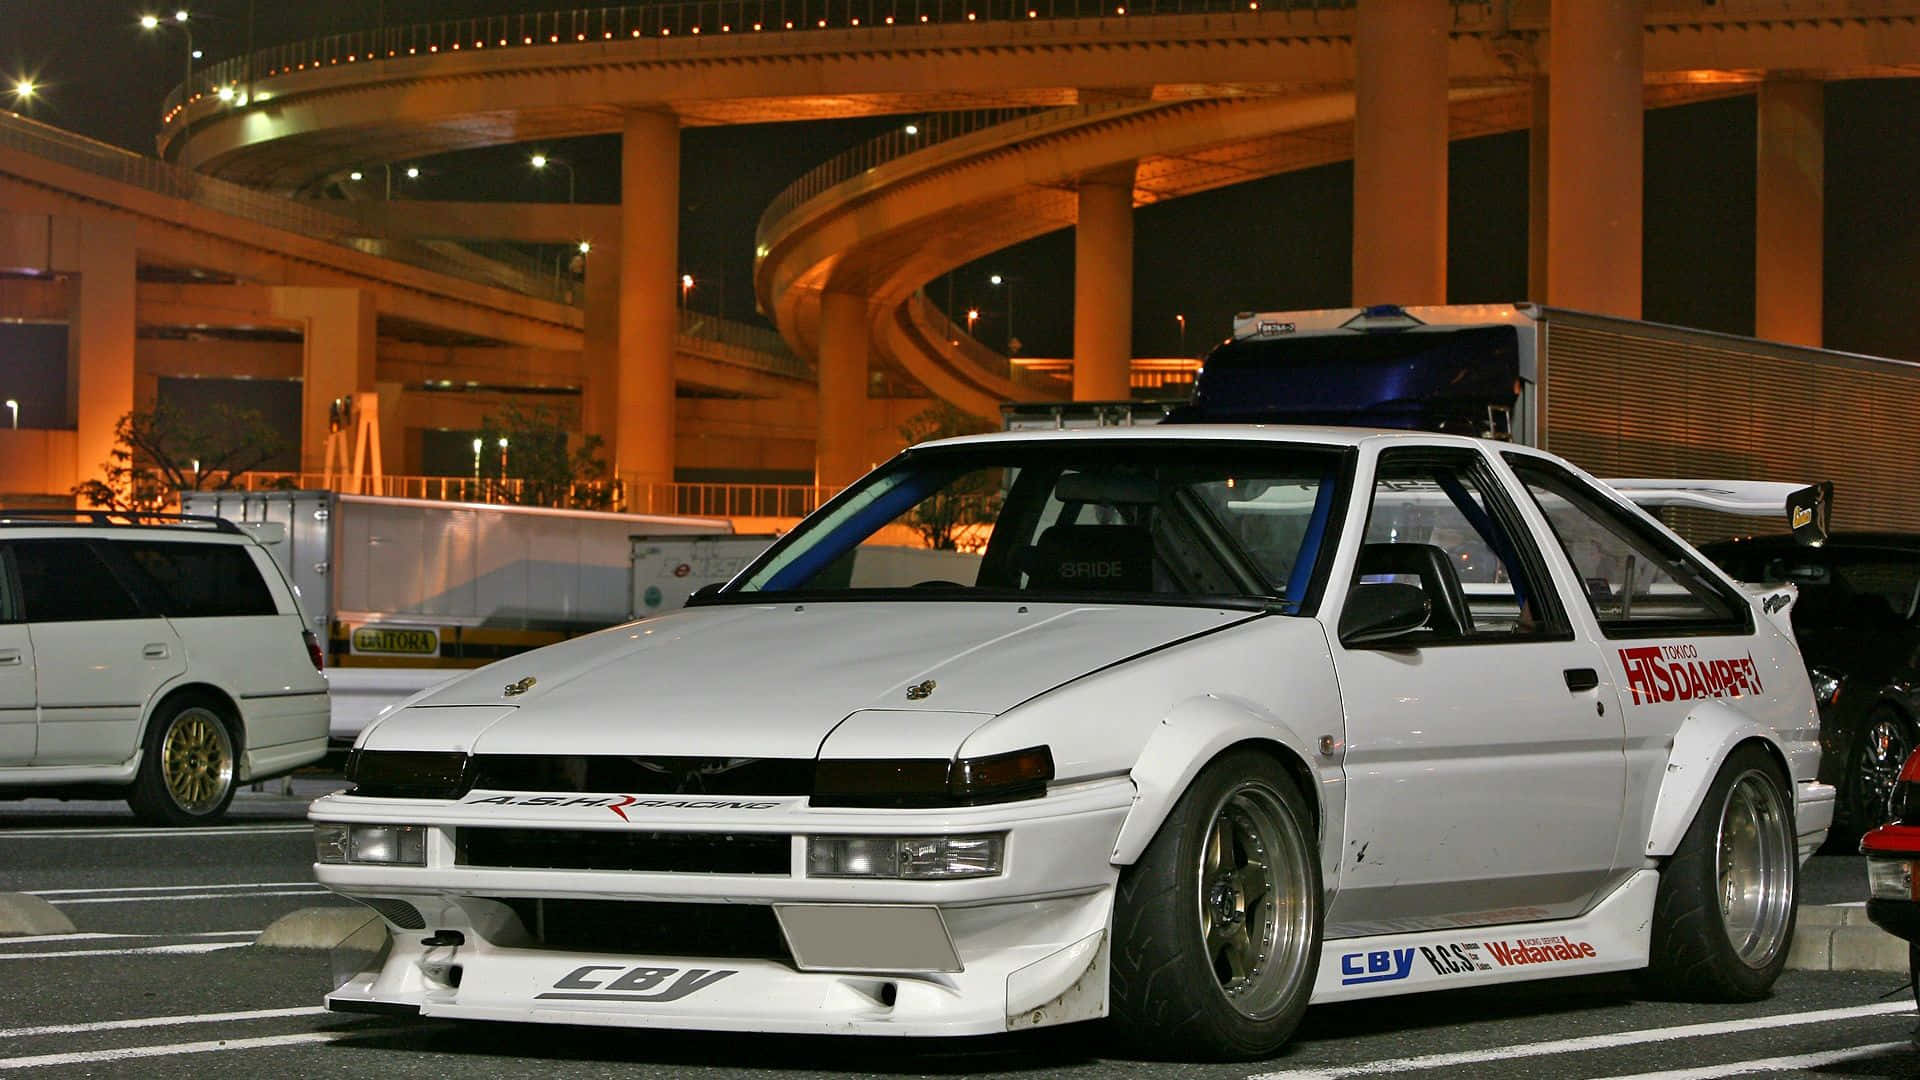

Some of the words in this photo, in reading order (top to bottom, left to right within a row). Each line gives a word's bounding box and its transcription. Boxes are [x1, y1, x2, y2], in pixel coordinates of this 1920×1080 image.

[1061, 562, 1122, 577] BRIDE
[1662, 644, 1698, 660] TOKICO
[1484, 936, 1596, 966] Watanabe
